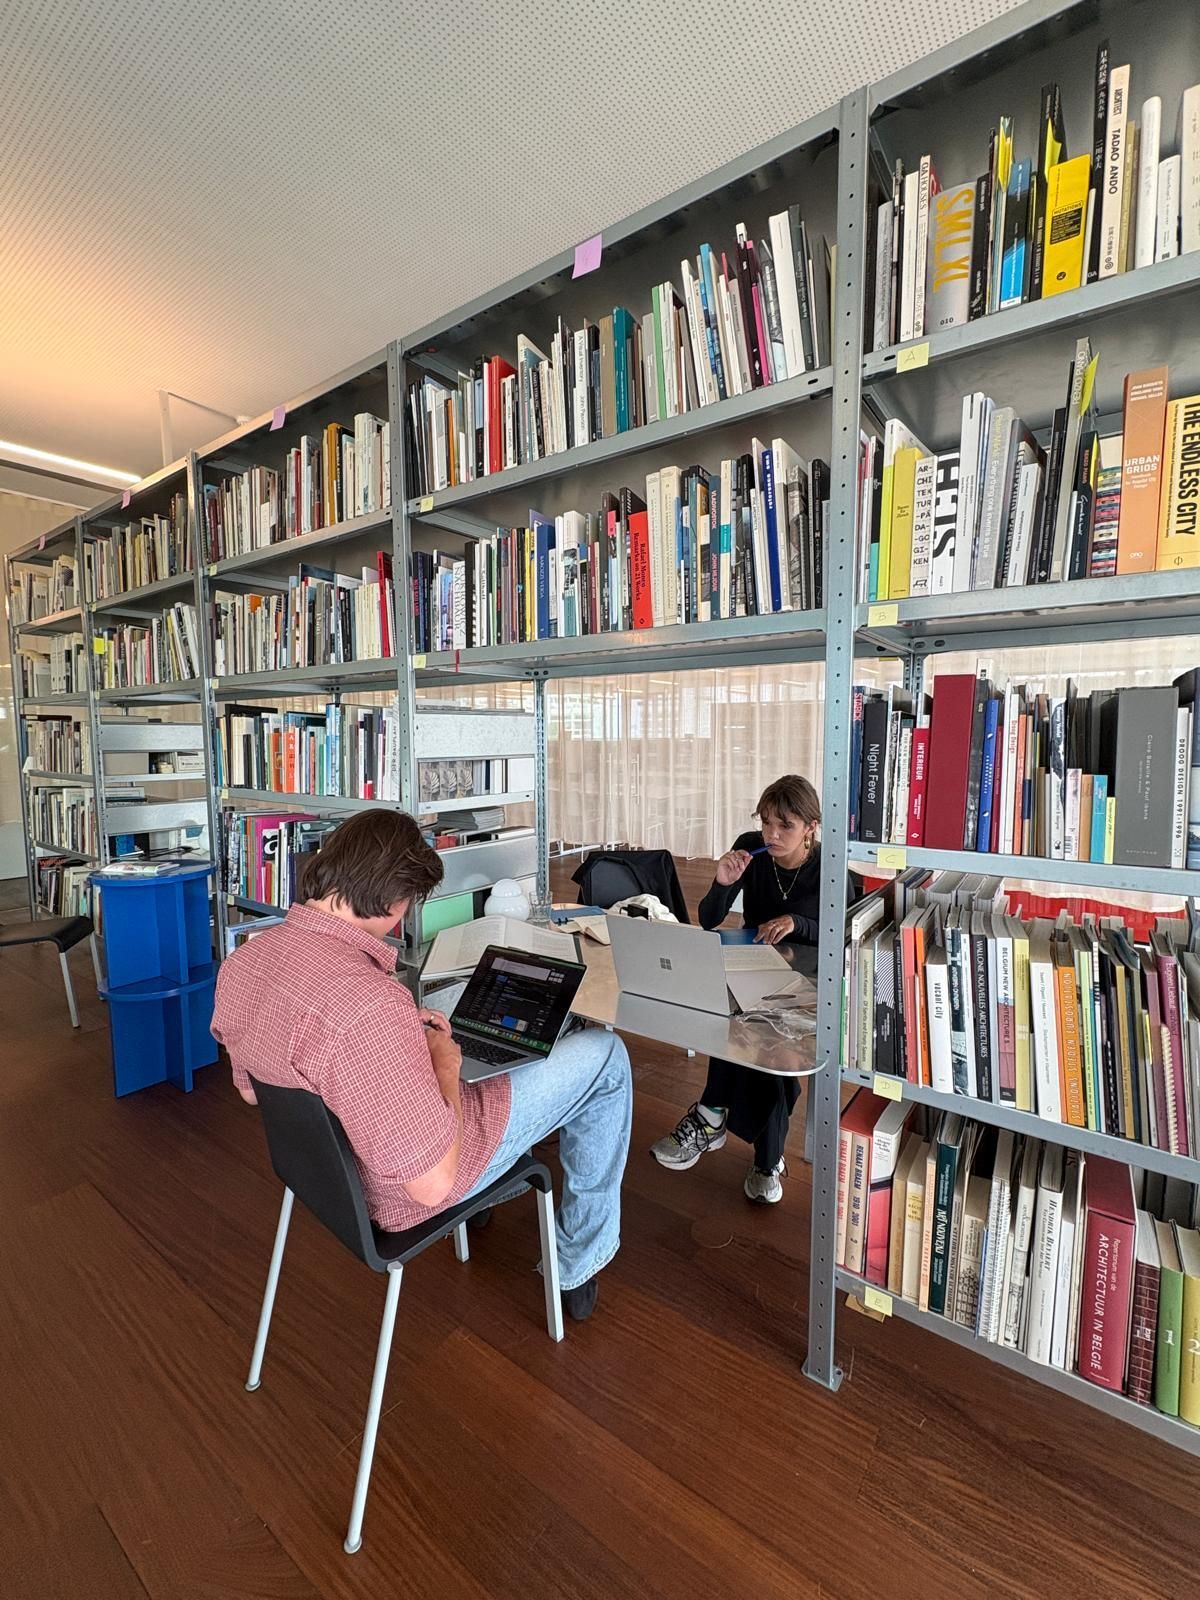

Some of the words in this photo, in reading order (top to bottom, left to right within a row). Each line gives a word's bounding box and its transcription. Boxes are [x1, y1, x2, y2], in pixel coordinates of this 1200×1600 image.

[1110, 129, 1121, 161] TADAO
[1109, 165, 1118, 194] ANDO
[919, 176, 928, 210] HOUSES
[1053, 202, 1082, 214] MUTATIONS
[1075, 351, 1086, 375] PIANO
[1072, 378, 1083, 405] RENZO
[1184, 402, 1200, 430] THE
[917, 465, 933, 473] AR-
[1125, 455, 1160, 467] URBAN
[1126, 464, 1158, 474] GRIDS
[1178, 433, 1200, 499] ENDLESS
[917, 476, 933, 485] CHI
[987, 460, 999, 497] Everything
[917, 489, 932, 497] TEK
[917, 499, 931, 508] TUR
[985, 512, 993, 536] invents
[1175, 503, 1197, 536] CITY
[634, 563, 639, 572] on
[913, 557, 929, 565] KEN
[853, 693, 862, 721] STARCK
[867, 743, 879, 773] Night
[915, 743, 925, 781] INTERIEUR
[1144, 755, 1152, 779] Bataille
[867, 775, 878, 804] Fever
[1176, 768, 1185, 796] DESIGN
[1143, 787, 1151, 802] Paul
[1175, 799, 1183, 839] 1991-1996
[976, 940, 984, 973] WALLONIE
[1164, 963, 1175, 987] Eugeen
[934, 983, 943, 1005] vacant
[977, 974, 986, 1009] NOUVELLES
[934, 1006, 943, 1019] city
[979, 1010, 988, 1059] ARCHITECTURES
[839, 1139, 849, 1163] RENAAT
[855, 1145, 865, 1168] RENAAT
[838, 1163, 848, 1183] BRAEM
[853, 1168, 864, 1190] BRAEM
[852, 1196, 861, 1209] 1910
[851, 1211, 860, 1227] 2001
[937, 1208, 947, 1222] ART
[1047, 1199, 1057, 1234] HENDRIK
[934, 1223, 946, 1255] NOUVEAU
[1044, 1237, 1055, 1272] BEYAERT
[1111, 1238, 1121, 1272] Repertorium
[1094, 1233, 1109, 1316] ARCHITECTUUR
[1110, 1283, 1118, 1291] de
[1092, 1318, 1103, 1332] IN
[1090, 1334, 1103, 1370] BELGIË
